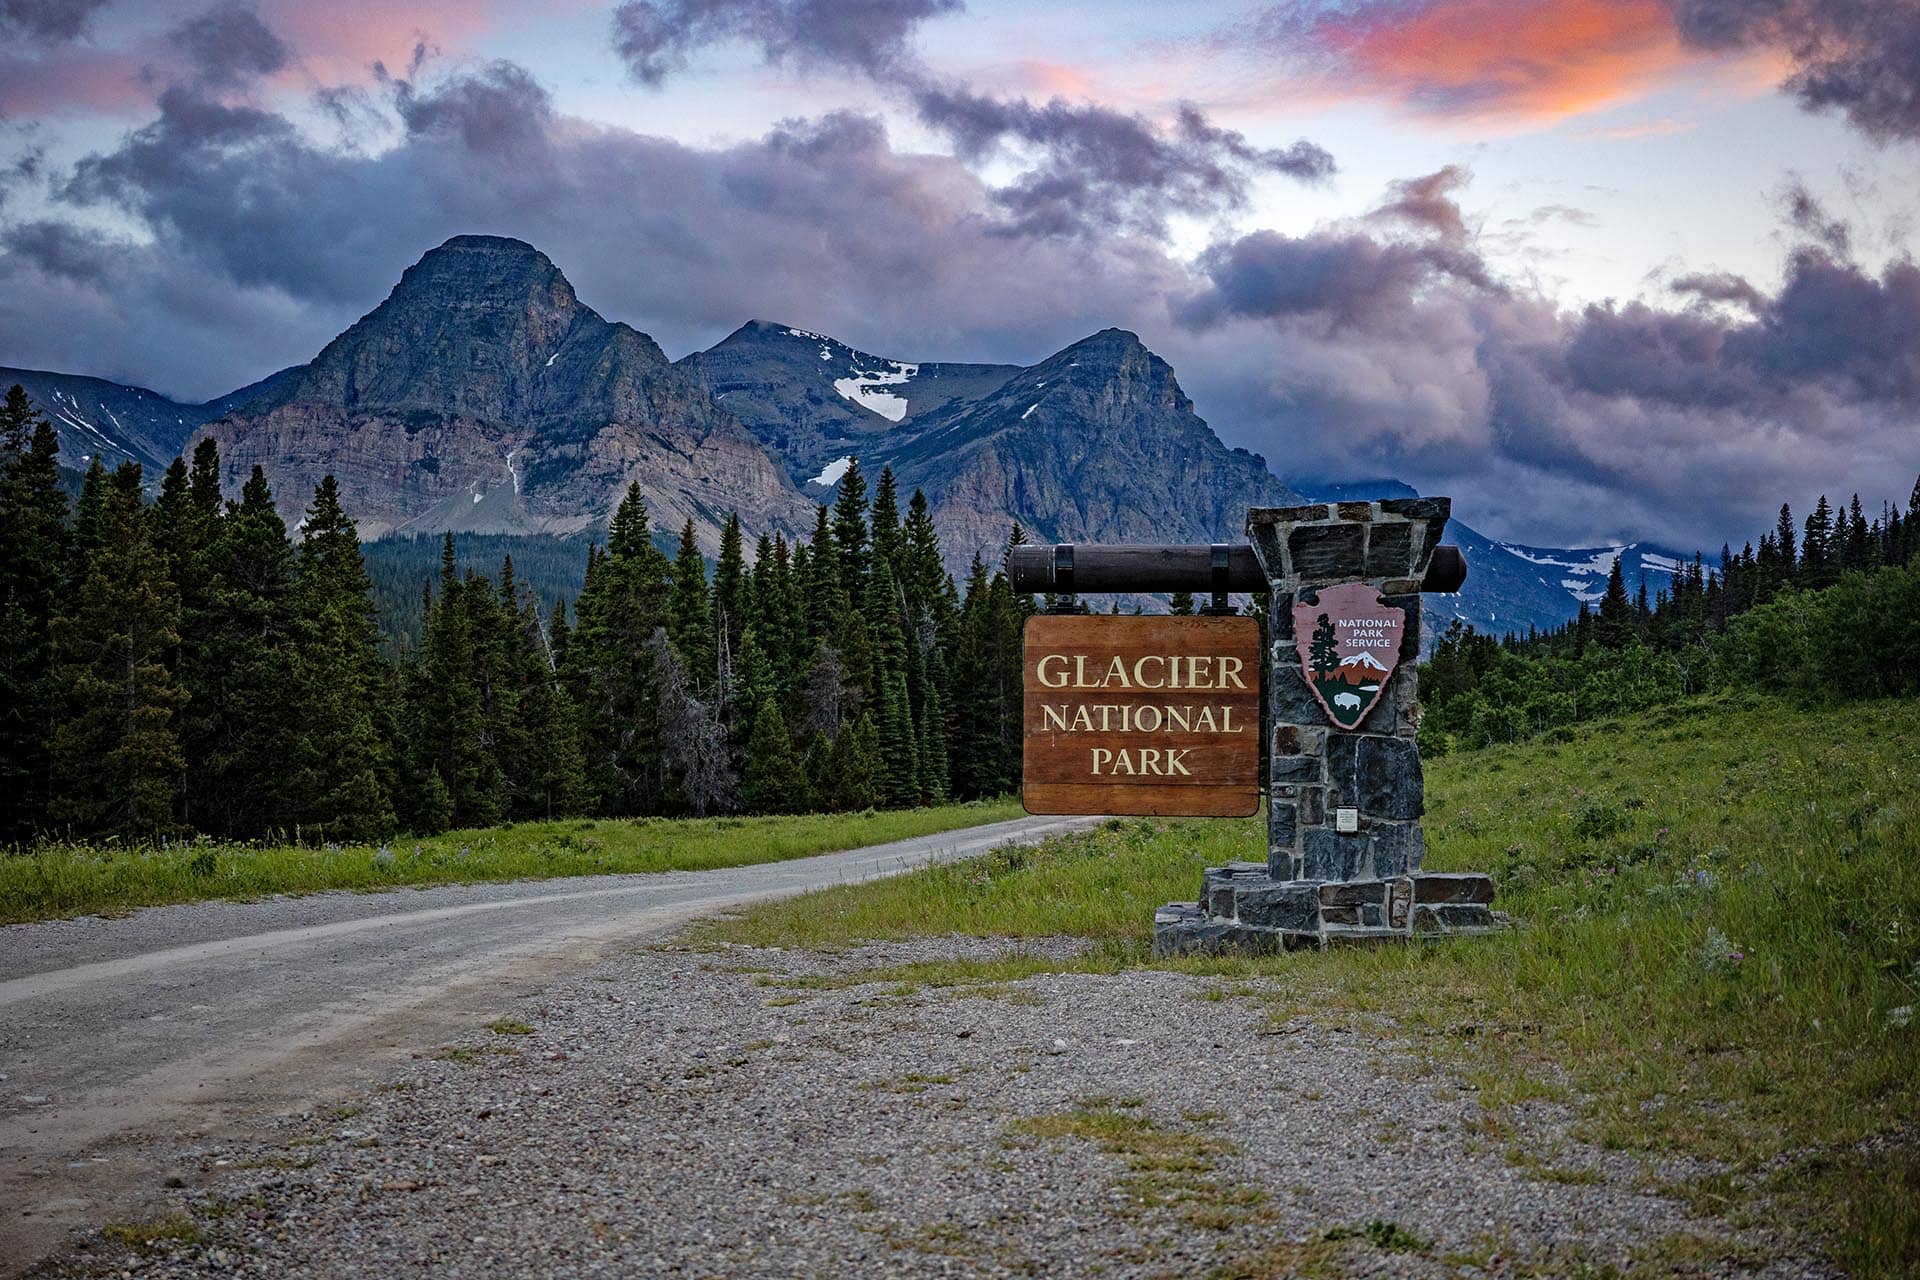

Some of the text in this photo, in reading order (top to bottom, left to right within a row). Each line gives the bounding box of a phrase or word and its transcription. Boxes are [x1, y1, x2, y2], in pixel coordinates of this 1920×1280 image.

[1339, 619, 1398, 628] NATIONAL
[1345, 638, 1391, 648] SERVICE
[1353, 629, 1384, 638] PARK
[1036, 655, 1248, 689] GLACIER
[1040, 704, 1243, 733] NATIONAL
[1090, 748, 1192, 776] PARK
